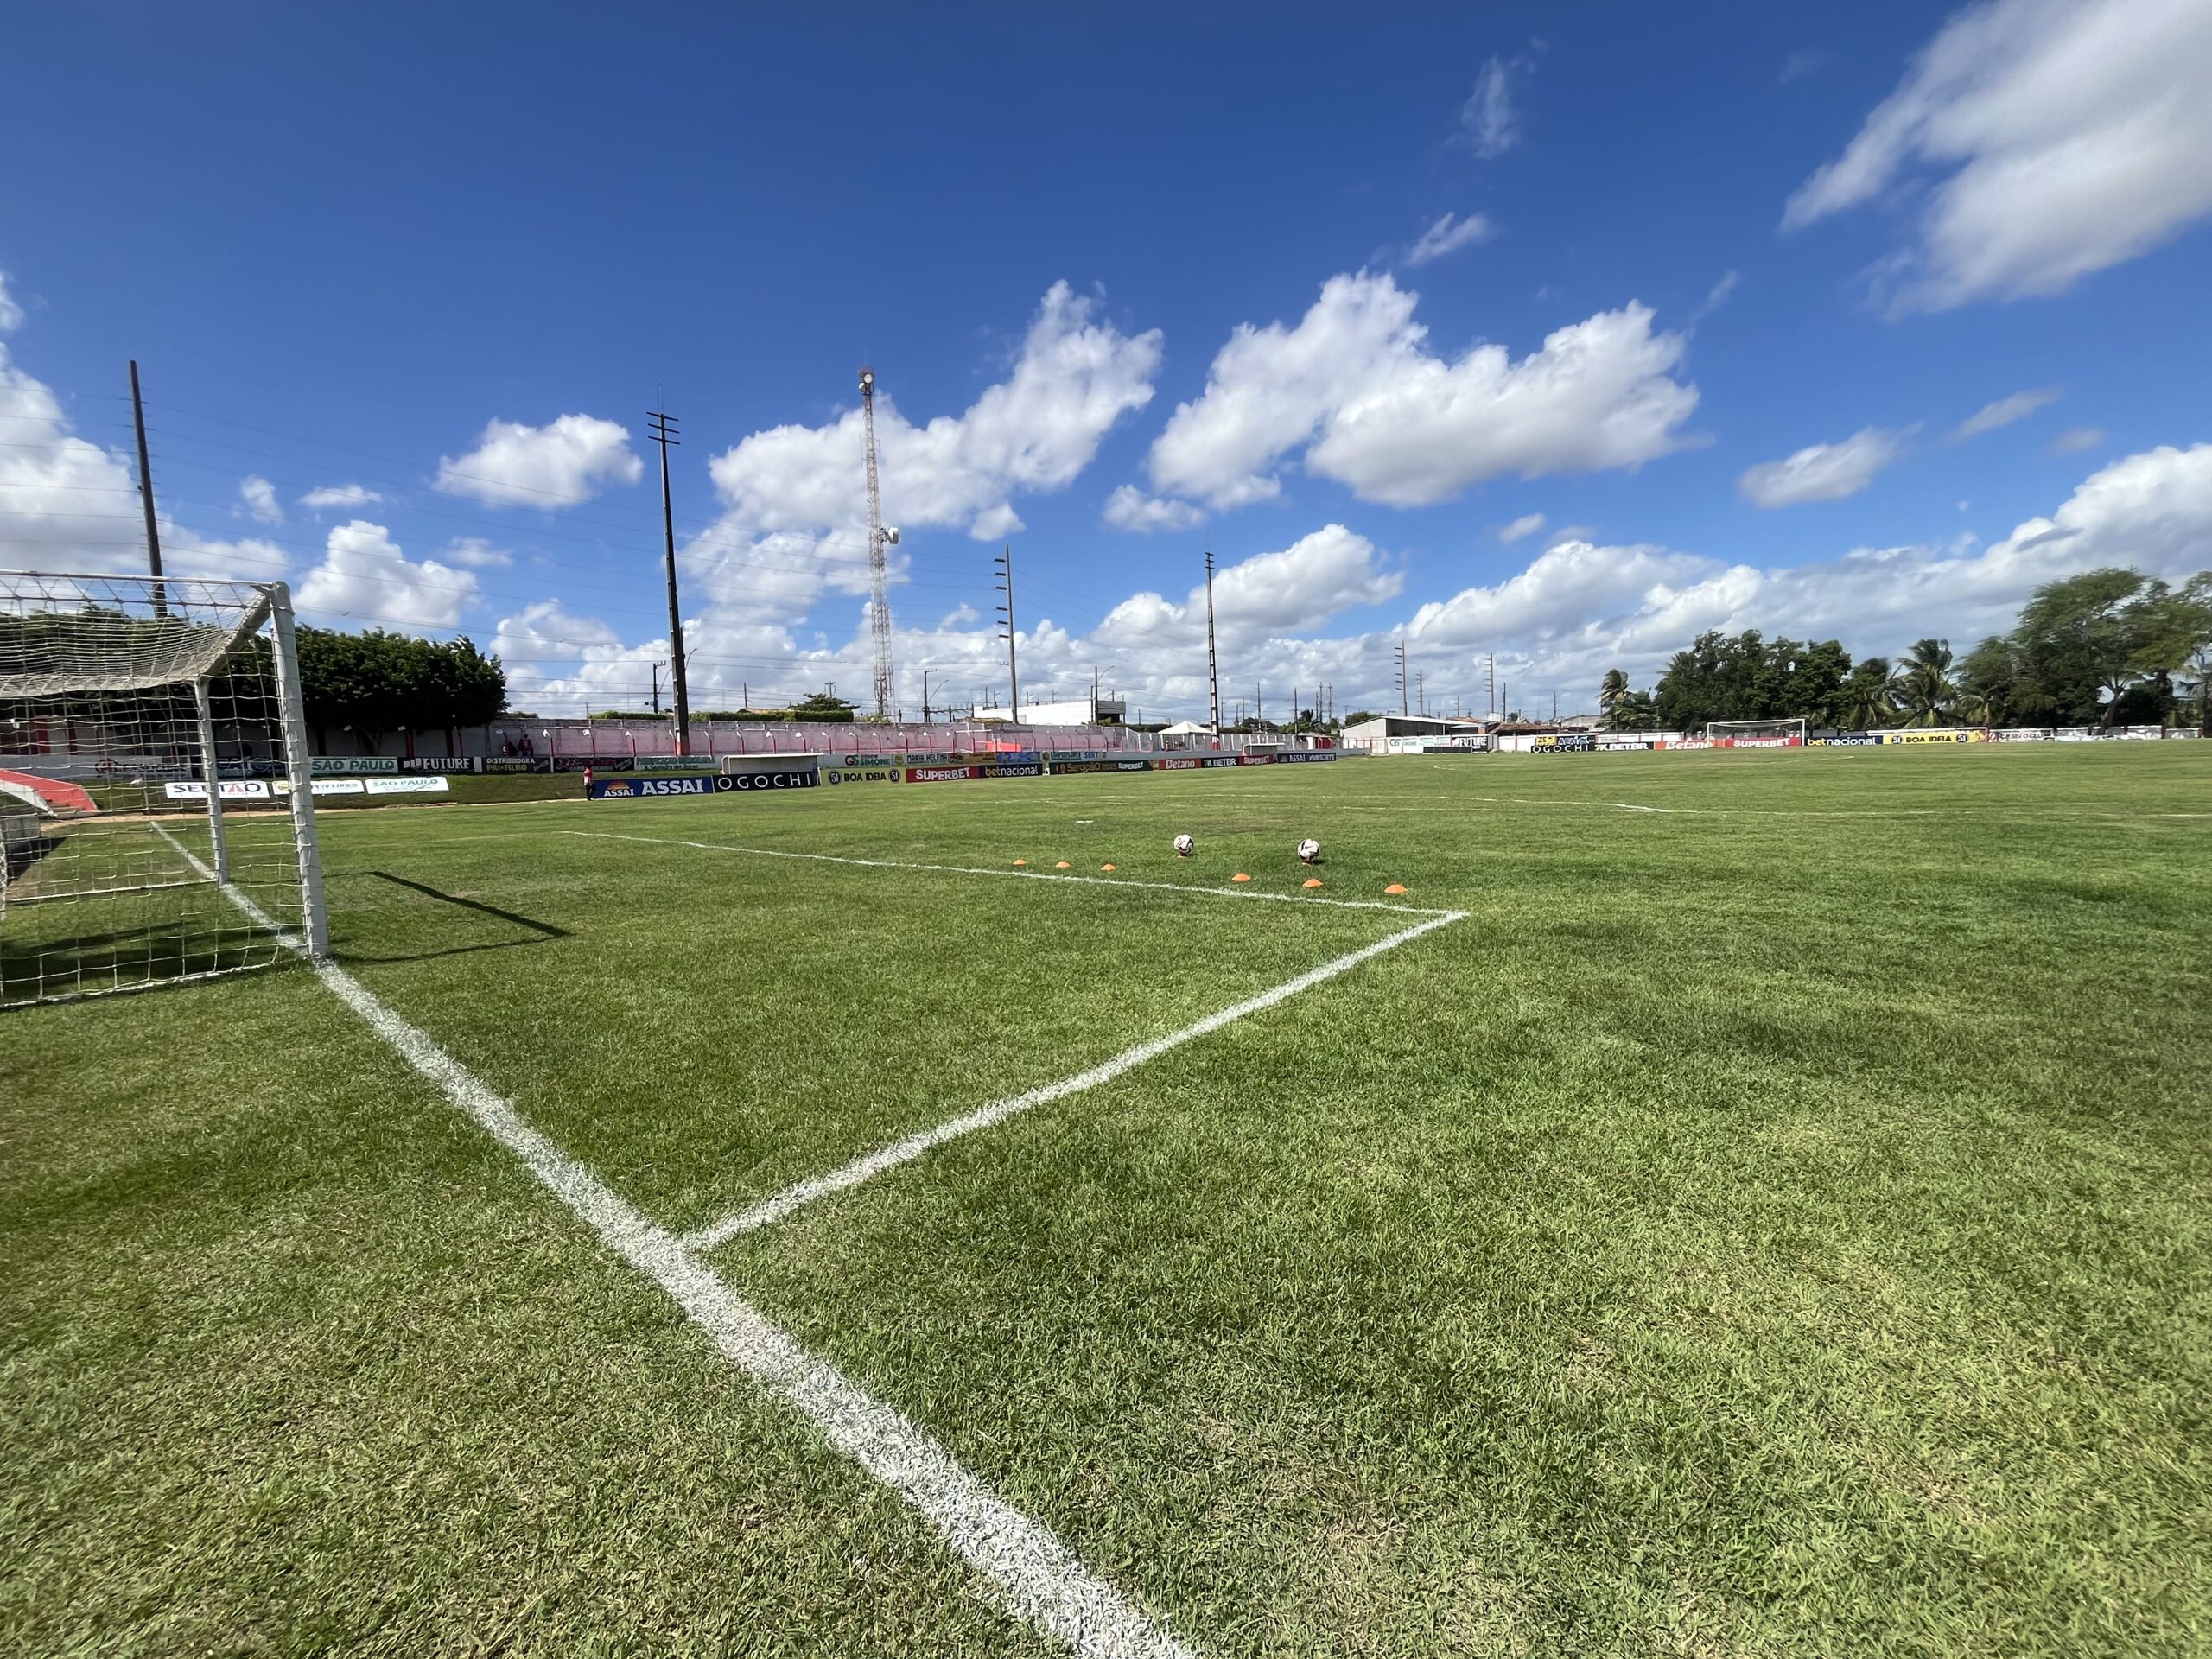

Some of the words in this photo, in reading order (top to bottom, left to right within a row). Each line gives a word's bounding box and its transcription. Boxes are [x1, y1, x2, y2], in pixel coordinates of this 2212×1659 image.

[1459, 737, 1487, 747] FUTURE
[1665, 741, 1713, 750] Betano
[1733, 738, 1790, 747] SUPERBET
[1807, 737, 1876, 746] betnacional
[349, 760, 395, 771] PAULO
[423, 758, 470, 770] FUTURE
[1118, 761, 1143, 769] SUPERBET
[1165, 760, 1195, 769] Betano
[916, 767, 969, 781] SUPERBET
[985, 766, 1038, 776] betnacional
[718, 773, 811, 790] OGOCHI
[831, 773, 839, 785] 51
[844, 773, 863, 782] BOA
[890, 770, 899, 781] 51
